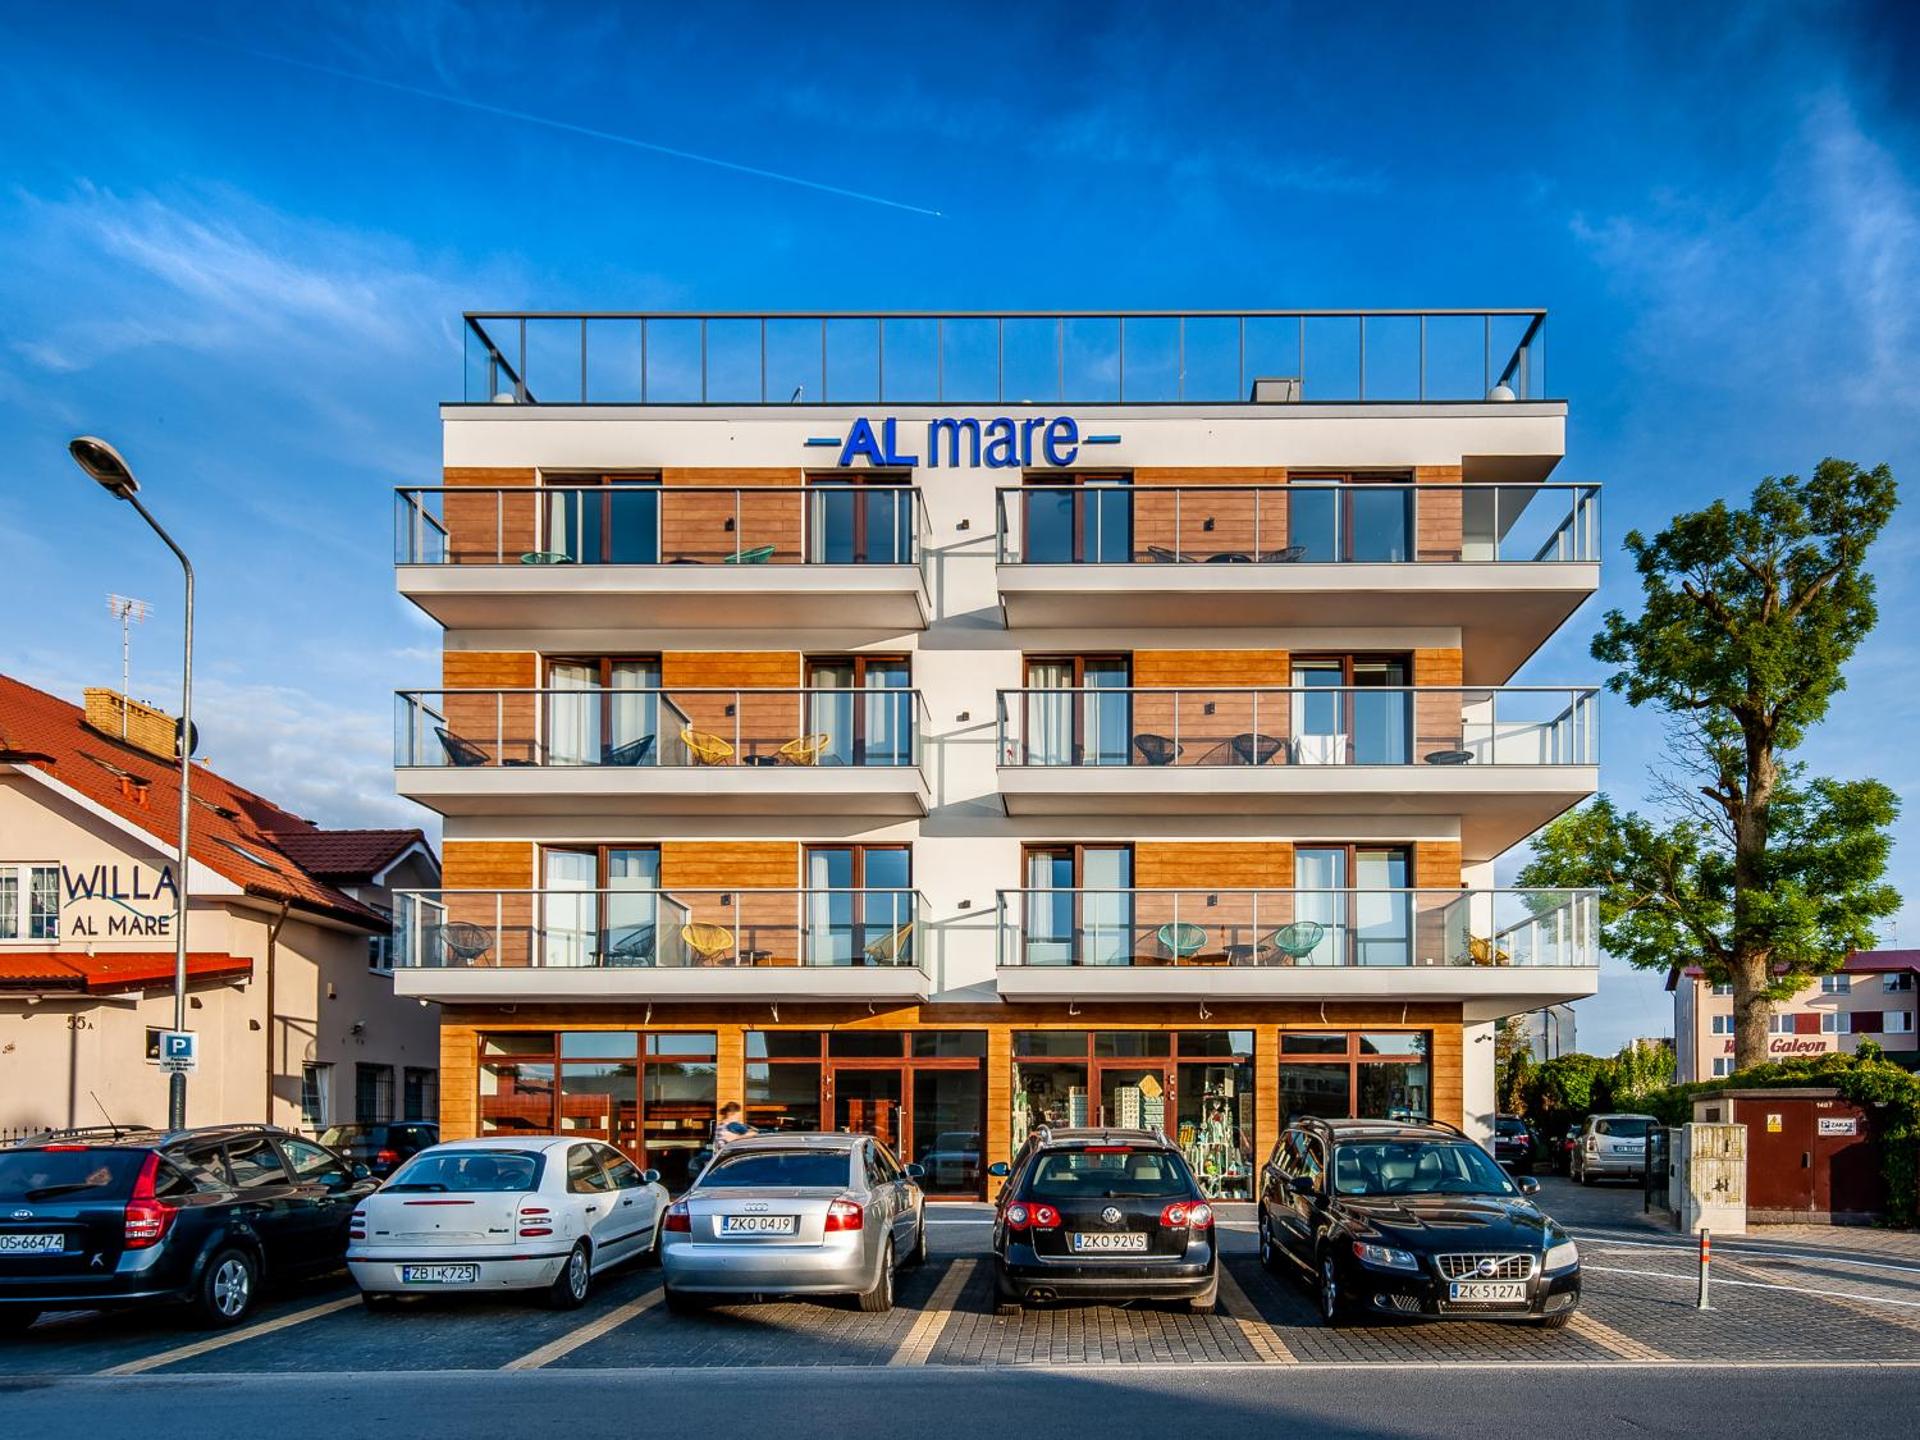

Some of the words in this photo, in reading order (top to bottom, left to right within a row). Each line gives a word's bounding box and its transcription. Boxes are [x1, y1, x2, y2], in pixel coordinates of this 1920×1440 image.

[838, 417, 919, 467] AL
[927, 416, 1079, 468] mare
[62, 865, 179, 899] WILLA
[72, 915, 98, 935] AL
[108, 915, 169, 935] MARE
[172, 1039, 187, 1053] P
[1770, 1038, 1827, 1053] Galeon
[730, 1218, 756, 1230] ZKO
[21, 1236, 63, 1249] 66474
[1084, 1235, 1109, 1247] ZKO
[1113, 1235, 1144, 1247] 92VS
[441, 1266, 472, 1279] K725
[1460, 1285, 1478, 1298] ZK
[1483, 1285, 1522, 1298] 5127A
